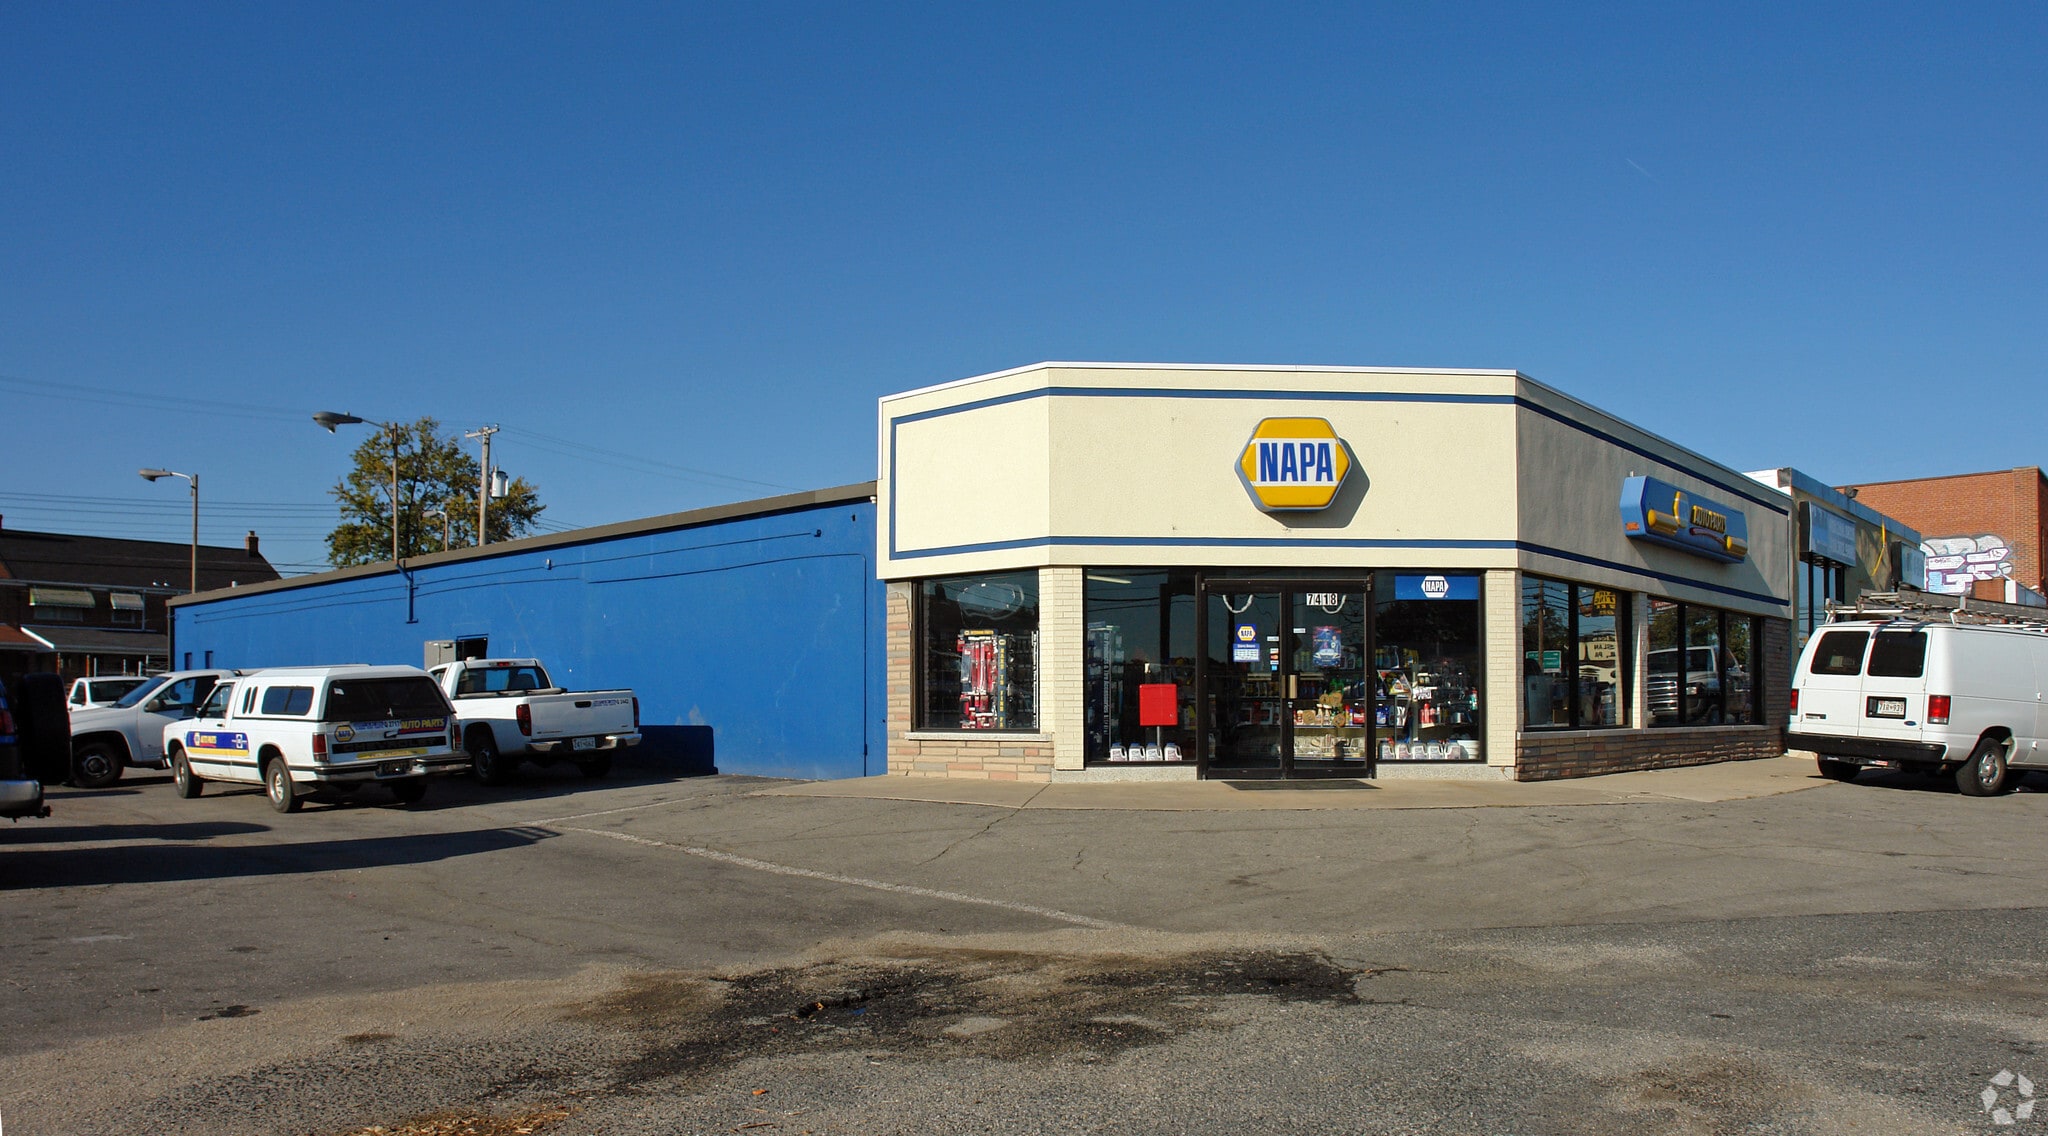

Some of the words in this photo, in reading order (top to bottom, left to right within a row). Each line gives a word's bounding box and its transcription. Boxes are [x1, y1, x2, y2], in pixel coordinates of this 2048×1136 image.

[1260, 443, 1333, 482] NAPA
[1425, 580, 1444, 592] NAPA
[1308, 593, 1336, 605] 7418
[401, 720, 420, 729] AUTO
[421, 718, 444, 728] PARTS
[343, 737, 436, 752] CHEVROLET
